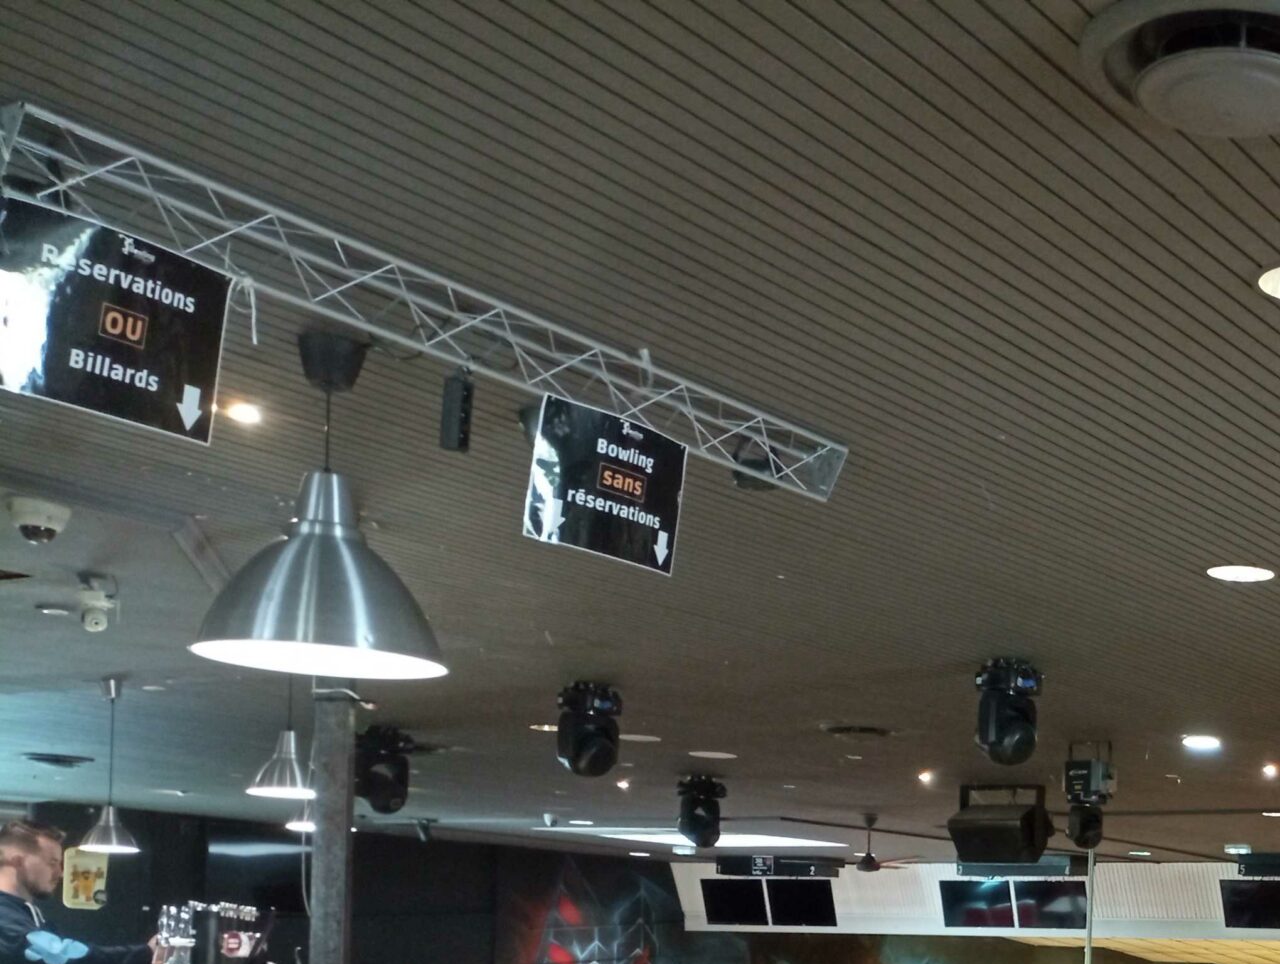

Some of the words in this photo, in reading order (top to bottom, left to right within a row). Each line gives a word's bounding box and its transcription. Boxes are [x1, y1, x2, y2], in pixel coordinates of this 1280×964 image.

[104, 311, 143, 342] OU
[68, 348, 159, 392] Billards
[596, 438, 654, 474] Bowling
[602, 470, 643, 496] sans
[567, 489, 661, 529] réservations
[809, 865, 816, 876] 2
[1239, 864, 1246, 875] 5
